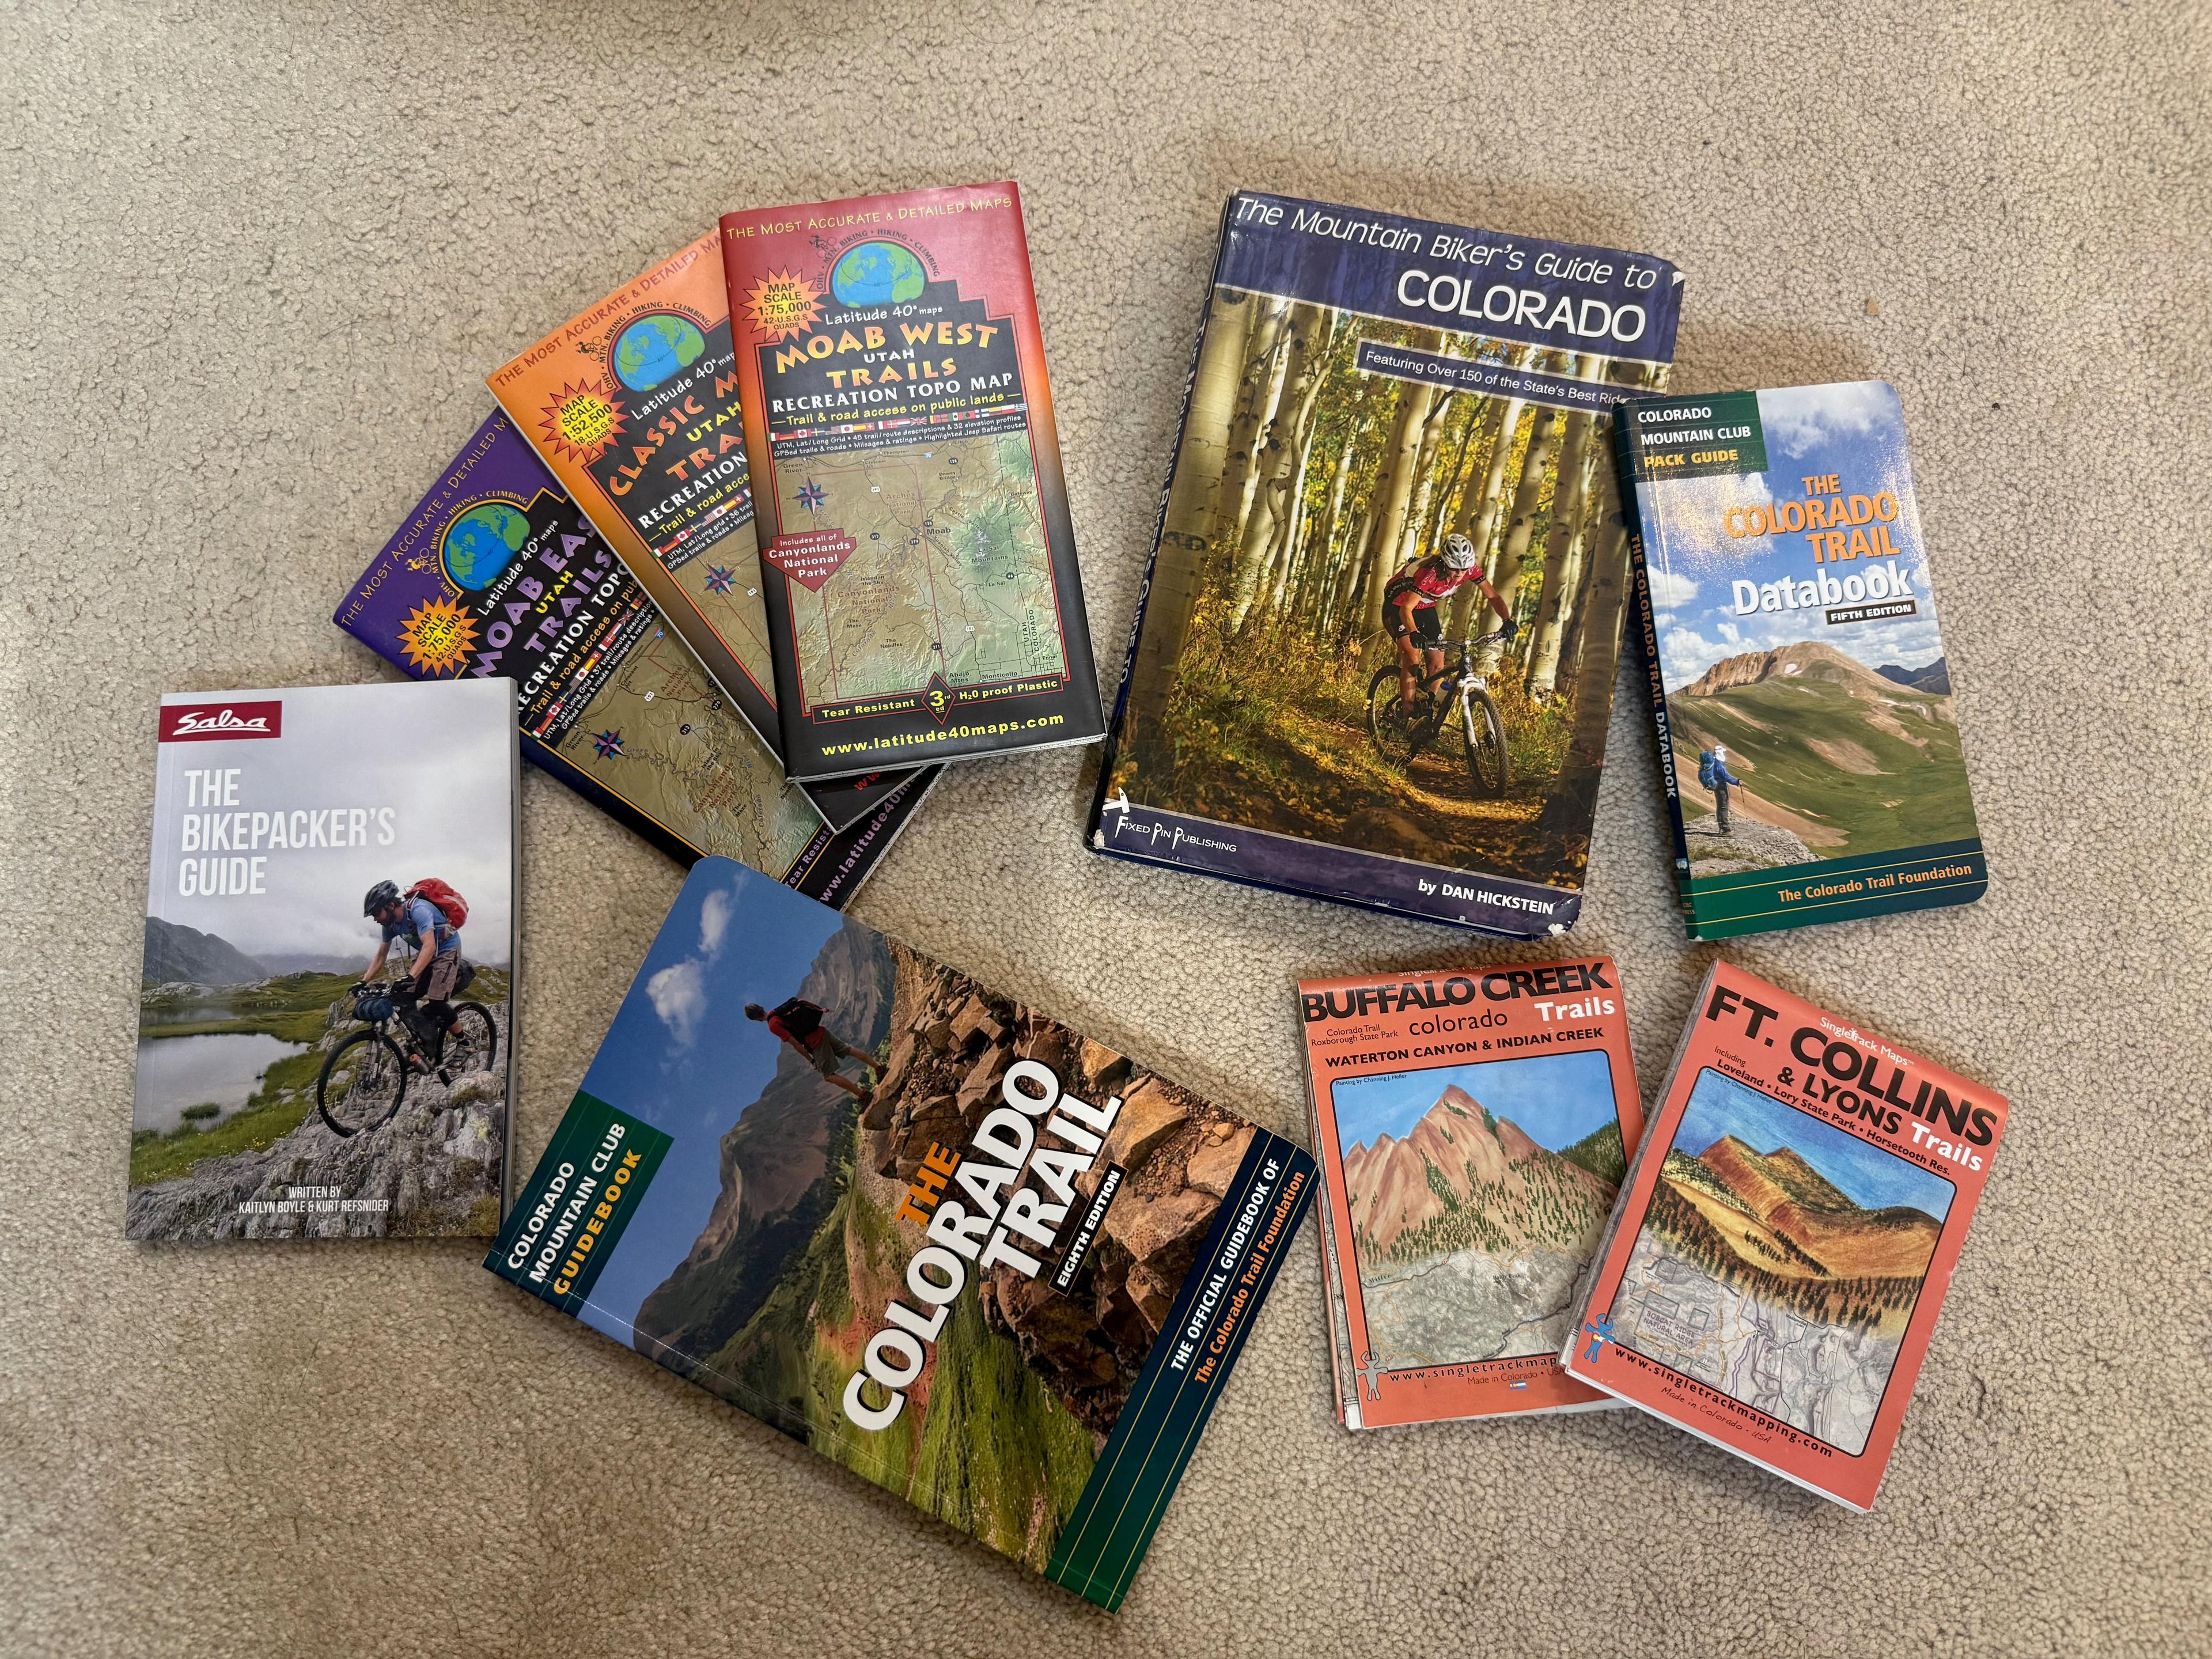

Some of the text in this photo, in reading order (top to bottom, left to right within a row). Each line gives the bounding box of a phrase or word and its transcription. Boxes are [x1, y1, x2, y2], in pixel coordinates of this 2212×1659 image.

[727, 227, 755, 240] THE
[760, 222, 802, 235] MOST
[808, 213, 880, 229] ACCURATE
[899, 203, 964, 219] DETAILED
[971, 197, 1012, 210] MAPS
[1234, 198, 1657, 290] The Mountain Biker's Guide to
[764, 291, 802, 302] SCALE
[768, 283, 796, 293] MAP
[1397, 269, 1647, 343] COLORADO
[758, 301, 812, 316] 1:75,000
[774, 321, 800, 329] QUADS
[825, 308, 887, 325] Latitude
[920, 306, 943, 316] maps
[775, 322, 998, 374] MOAB WEST
[864, 350, 915, 363] UTAH
[827, 358, 956, 388] TRAILS
[1366, 351, 1597, 403] Featuring Over 150 of the State's Best
[560, 395, 585, 416] MAP
[562, 398, 599, 427] SCALE
[772, 374, 1013, 413] RECREATION TOPO MAP
[786, 393, 1005, 426] Trail & road access on public lands
[562, 404, 613, 440] 1:52,500
[687, 402, 741, 442] UTAH
[1638, 407, 1711, 423] COLORADO
[609, 395, 703, 497] CLASSIC
[1641, 426, 1751, 446] MOUNTAIN CLUB
[1643, 449, 1738, 468] PACK GUIDE
[638, 452, 748, 529] RECREATION
[1801, 474, 1842, 496] THE
[1723, 490, 1899, 539] COLORADO
[769, 541, 851, 559] Canyonlands
[780, 536, 810, 547] Includes
[1805, 526, 1901, 563] TRAIL
[785, 555, 839, 568] National
[798, 568, 827, 578] Park
[522, 550, 612, 653] TRAILS
[535, 570, 574, 614] UTAH
[1732, 560, 1914, 616] Databook
[411, 611, 433, 635] MAP
[416, 613, 446, 647] SCALE
[471, 577, 543, 678] MOAB
[1830, 603, 1912, 622] FIFTH EDITION
[421, 612, 462, 658] 1:75,000
[1631, 533, 1677, 798] THE COLORADO TRAIL DATABOOK
[982, 685, 1013, 699] proof
[1017, 679, 1058, 693] Plastic
[173, 709, 271, 735] Salsa
[822, 699, 915, 719] Tear Resistant
[822, 713, 1064, 756] www.latitude40maps.com
[184, 768, 241, 807] THE
[181, 807, 396, 852] BIKEPACKER'S
[179, 857, 267, 897] GUIDE
[1778, 863, 1972, 902] The Colorado Trail Foundation
[1418, 879, 1554, 915] by DAN HICKSTEIN
[1301, 963, 1613, 1022] BUFFALO CREEK
[1326, 1024, 1381, 1037] Colorado Trail
[1409, 997, 1615, 1036] colorado Trails
[1311, 1030, 1399, 1047] Roxborough State Park
[1325, 1028, 1604, 1068] WATERTON CANYON & INDIAN CREEK
[1714, 1045, 1747, 1067] Including
[1706, 984, 1997, 1146] FT. COLLINS
[1717, 1059, 1950, 1176] Loveland Lory State Park Horsetooth Res.
[1777, 1066, 1983, 1172] & LYONS Trails
[288, 1186, 342, 1198] WRITTEN BY
[529, 1123, 626, 1283] MOUNTAIN CLUB
[896, 1142, 960, 1226] THE
[981, 1092, 1125, 1279] TRAIL
[238, 1199, 389, 1214] KAITLYN BOYLE & KURT REFSNIDER
[507, 1162, 574, 1269] COLORADO
[554, 1149, 642, 1296] GUIDEBOOK
[842, 1058, 1060, 1431] COLORADO
[1056, 1169, 1121, 1289] EIGHTH EDITION
[1171, 1158, 1281, 1372] THE OFFICIAL GUIDEBOOK OF
[1194, 1171, 1305, 1384] The Colorado Trail Foundation
[1643, 1317, 1673, 1336] NATURAL
[1676, 1334, 1693, 1345] AREA
[1647, 1311, 1673, 1326] BOBCAT
[1675, 1324, 1695, 1338] RIDGE
[1390, 1357, 1556, 1382] www.singletrackmap
[1615, 1347, 1832, 1458] www.singletrackmapping.com
[1661, 1386, 1771, 1444] Made in Colorado USA
